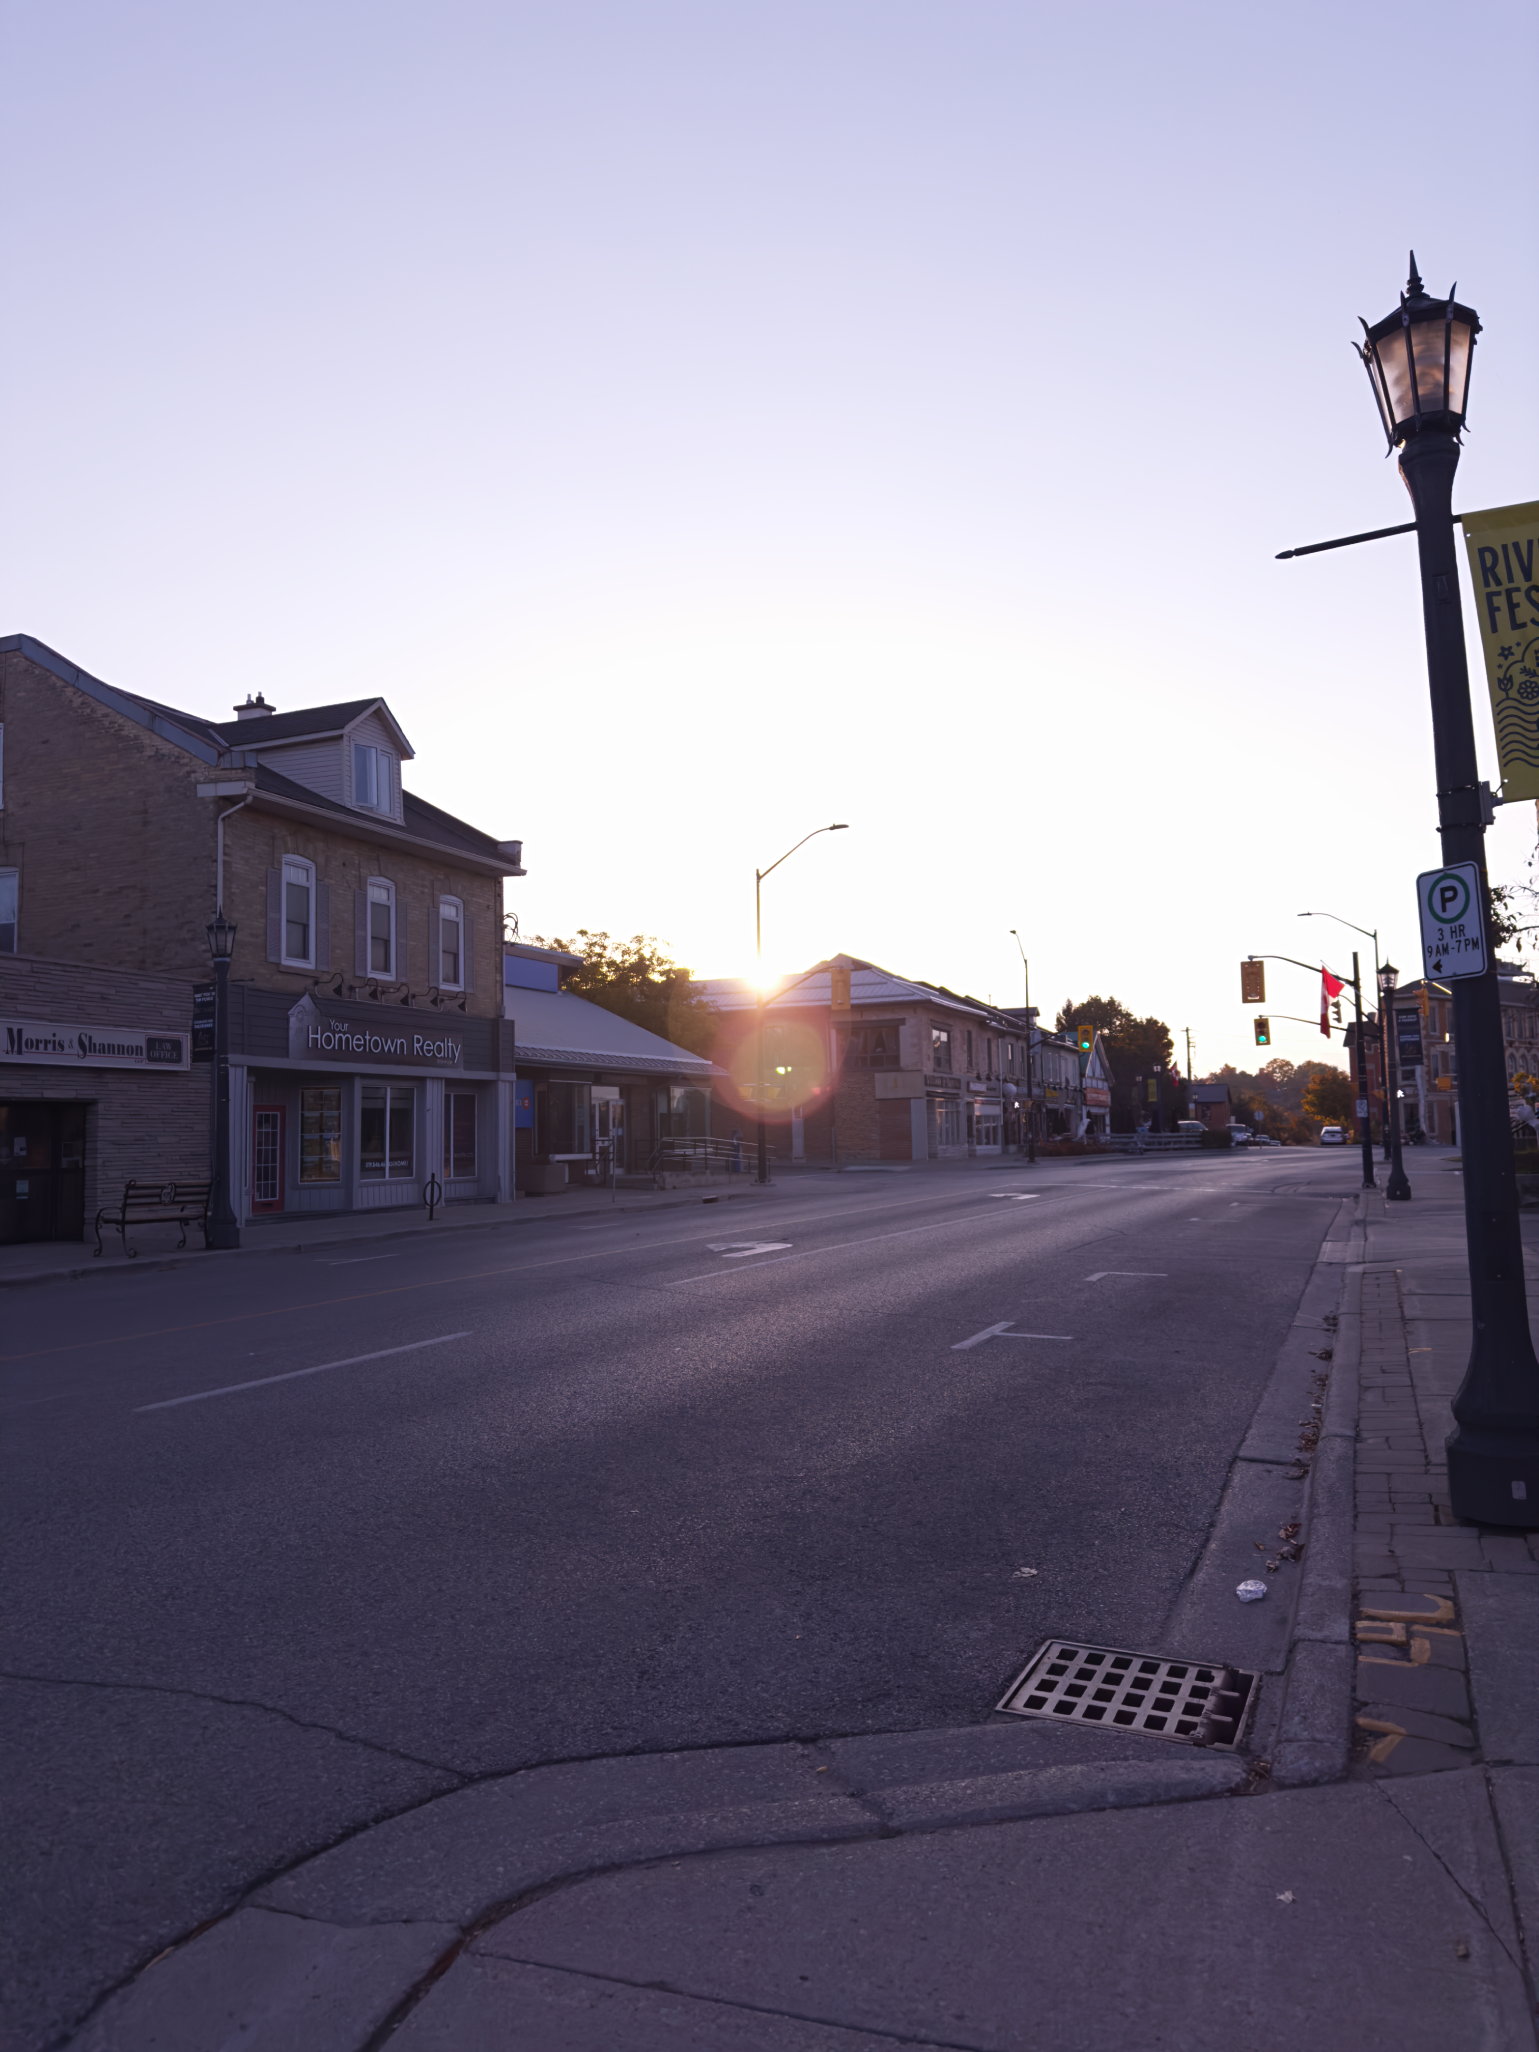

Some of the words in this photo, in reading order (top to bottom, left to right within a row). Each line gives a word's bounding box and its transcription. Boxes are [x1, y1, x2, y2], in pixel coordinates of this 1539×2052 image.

[1477, 538, 1539, 588] RIV
[1440, 885, 1458, 913] P
[1437, 928, 1445, 942] 3
[1450, 924, 1466, 939] HR
[329, 1019, 349, 1032] Your
[5, 1027, 65, 1055] Morris
[68, 1038, 74, 1050] &
[77, 1032, 144, 1059] Shannon
[155, 1041, 173, 1050] LAW
[307, 1025, 407, 1055] Hometown
[413, 1034, 461, 1063] Realty
[149, 1050, 179, 1060] OFFICE
